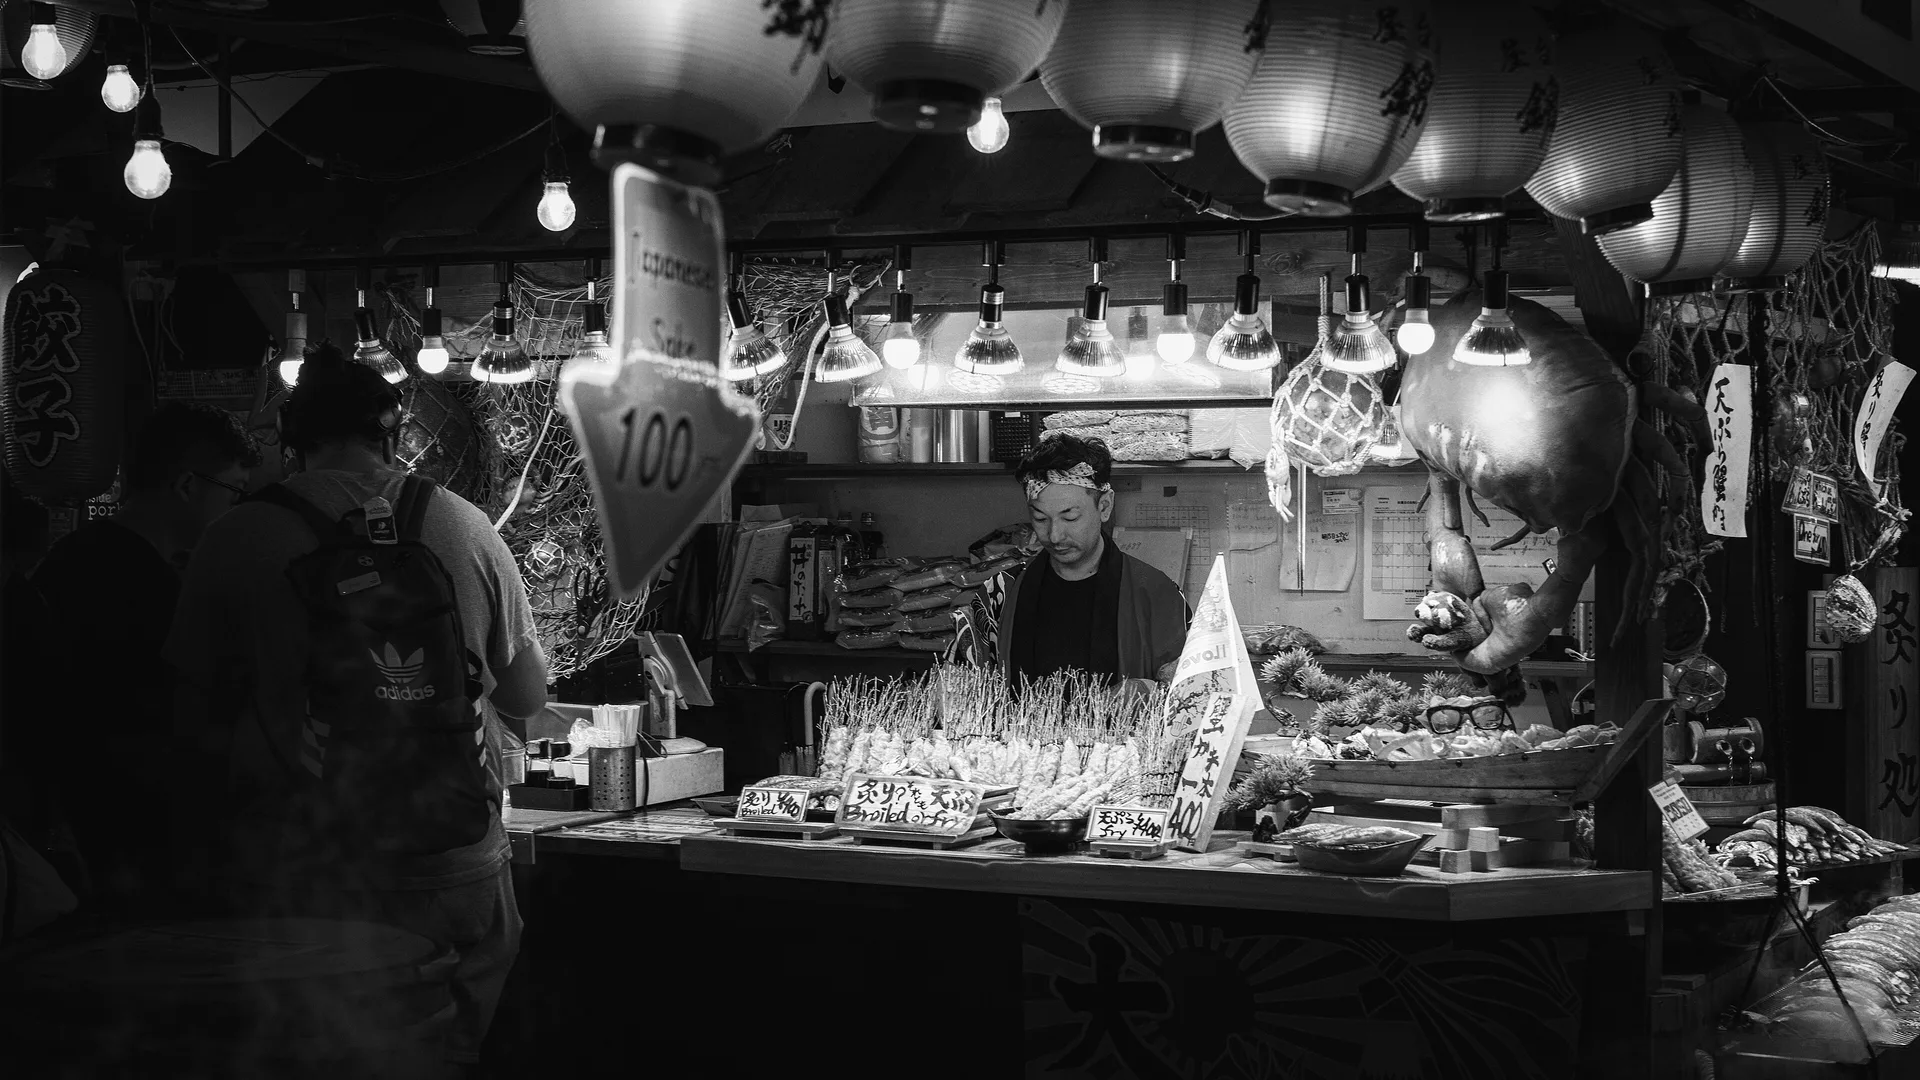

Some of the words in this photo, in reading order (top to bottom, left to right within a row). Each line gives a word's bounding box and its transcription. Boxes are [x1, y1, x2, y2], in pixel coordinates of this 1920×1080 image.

[12, 283, 80, 467] 餃子
[617, 407, 694, 490] 100
[374, 684, 436, 701] adidas
[741, 805, 778, 817] Broiled
[843, 803, 910, 824] Broiled
[1099, 824, 1128, 841] fry
